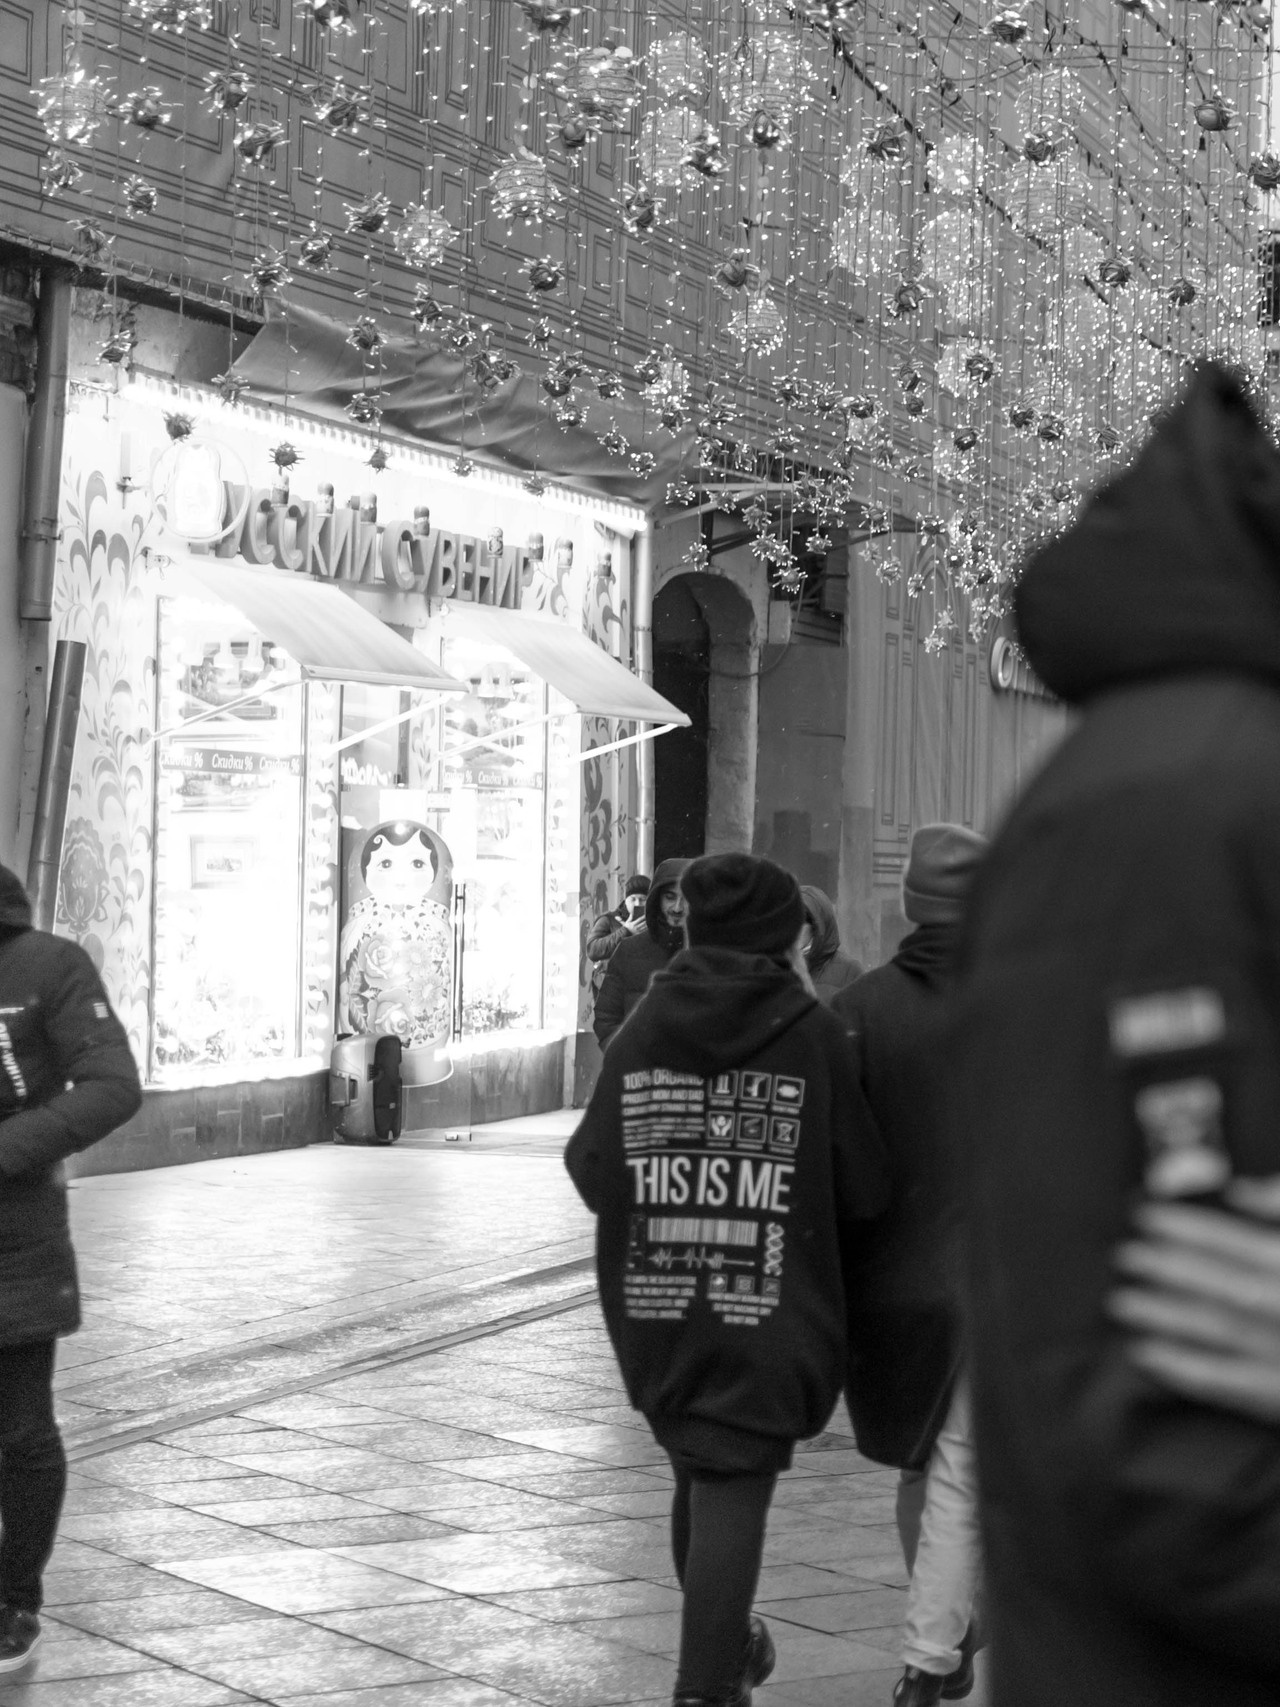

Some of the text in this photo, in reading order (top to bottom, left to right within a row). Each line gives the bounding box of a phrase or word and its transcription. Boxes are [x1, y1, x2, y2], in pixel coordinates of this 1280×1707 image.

[188, 480, 534, 609] УССКИЙ СУВЕНИР
[211, 753, 244, 770] Скидки
[623, 1070, 651, 1090] 100%
[626, 1156, 796, 1213] THIS IS ME
